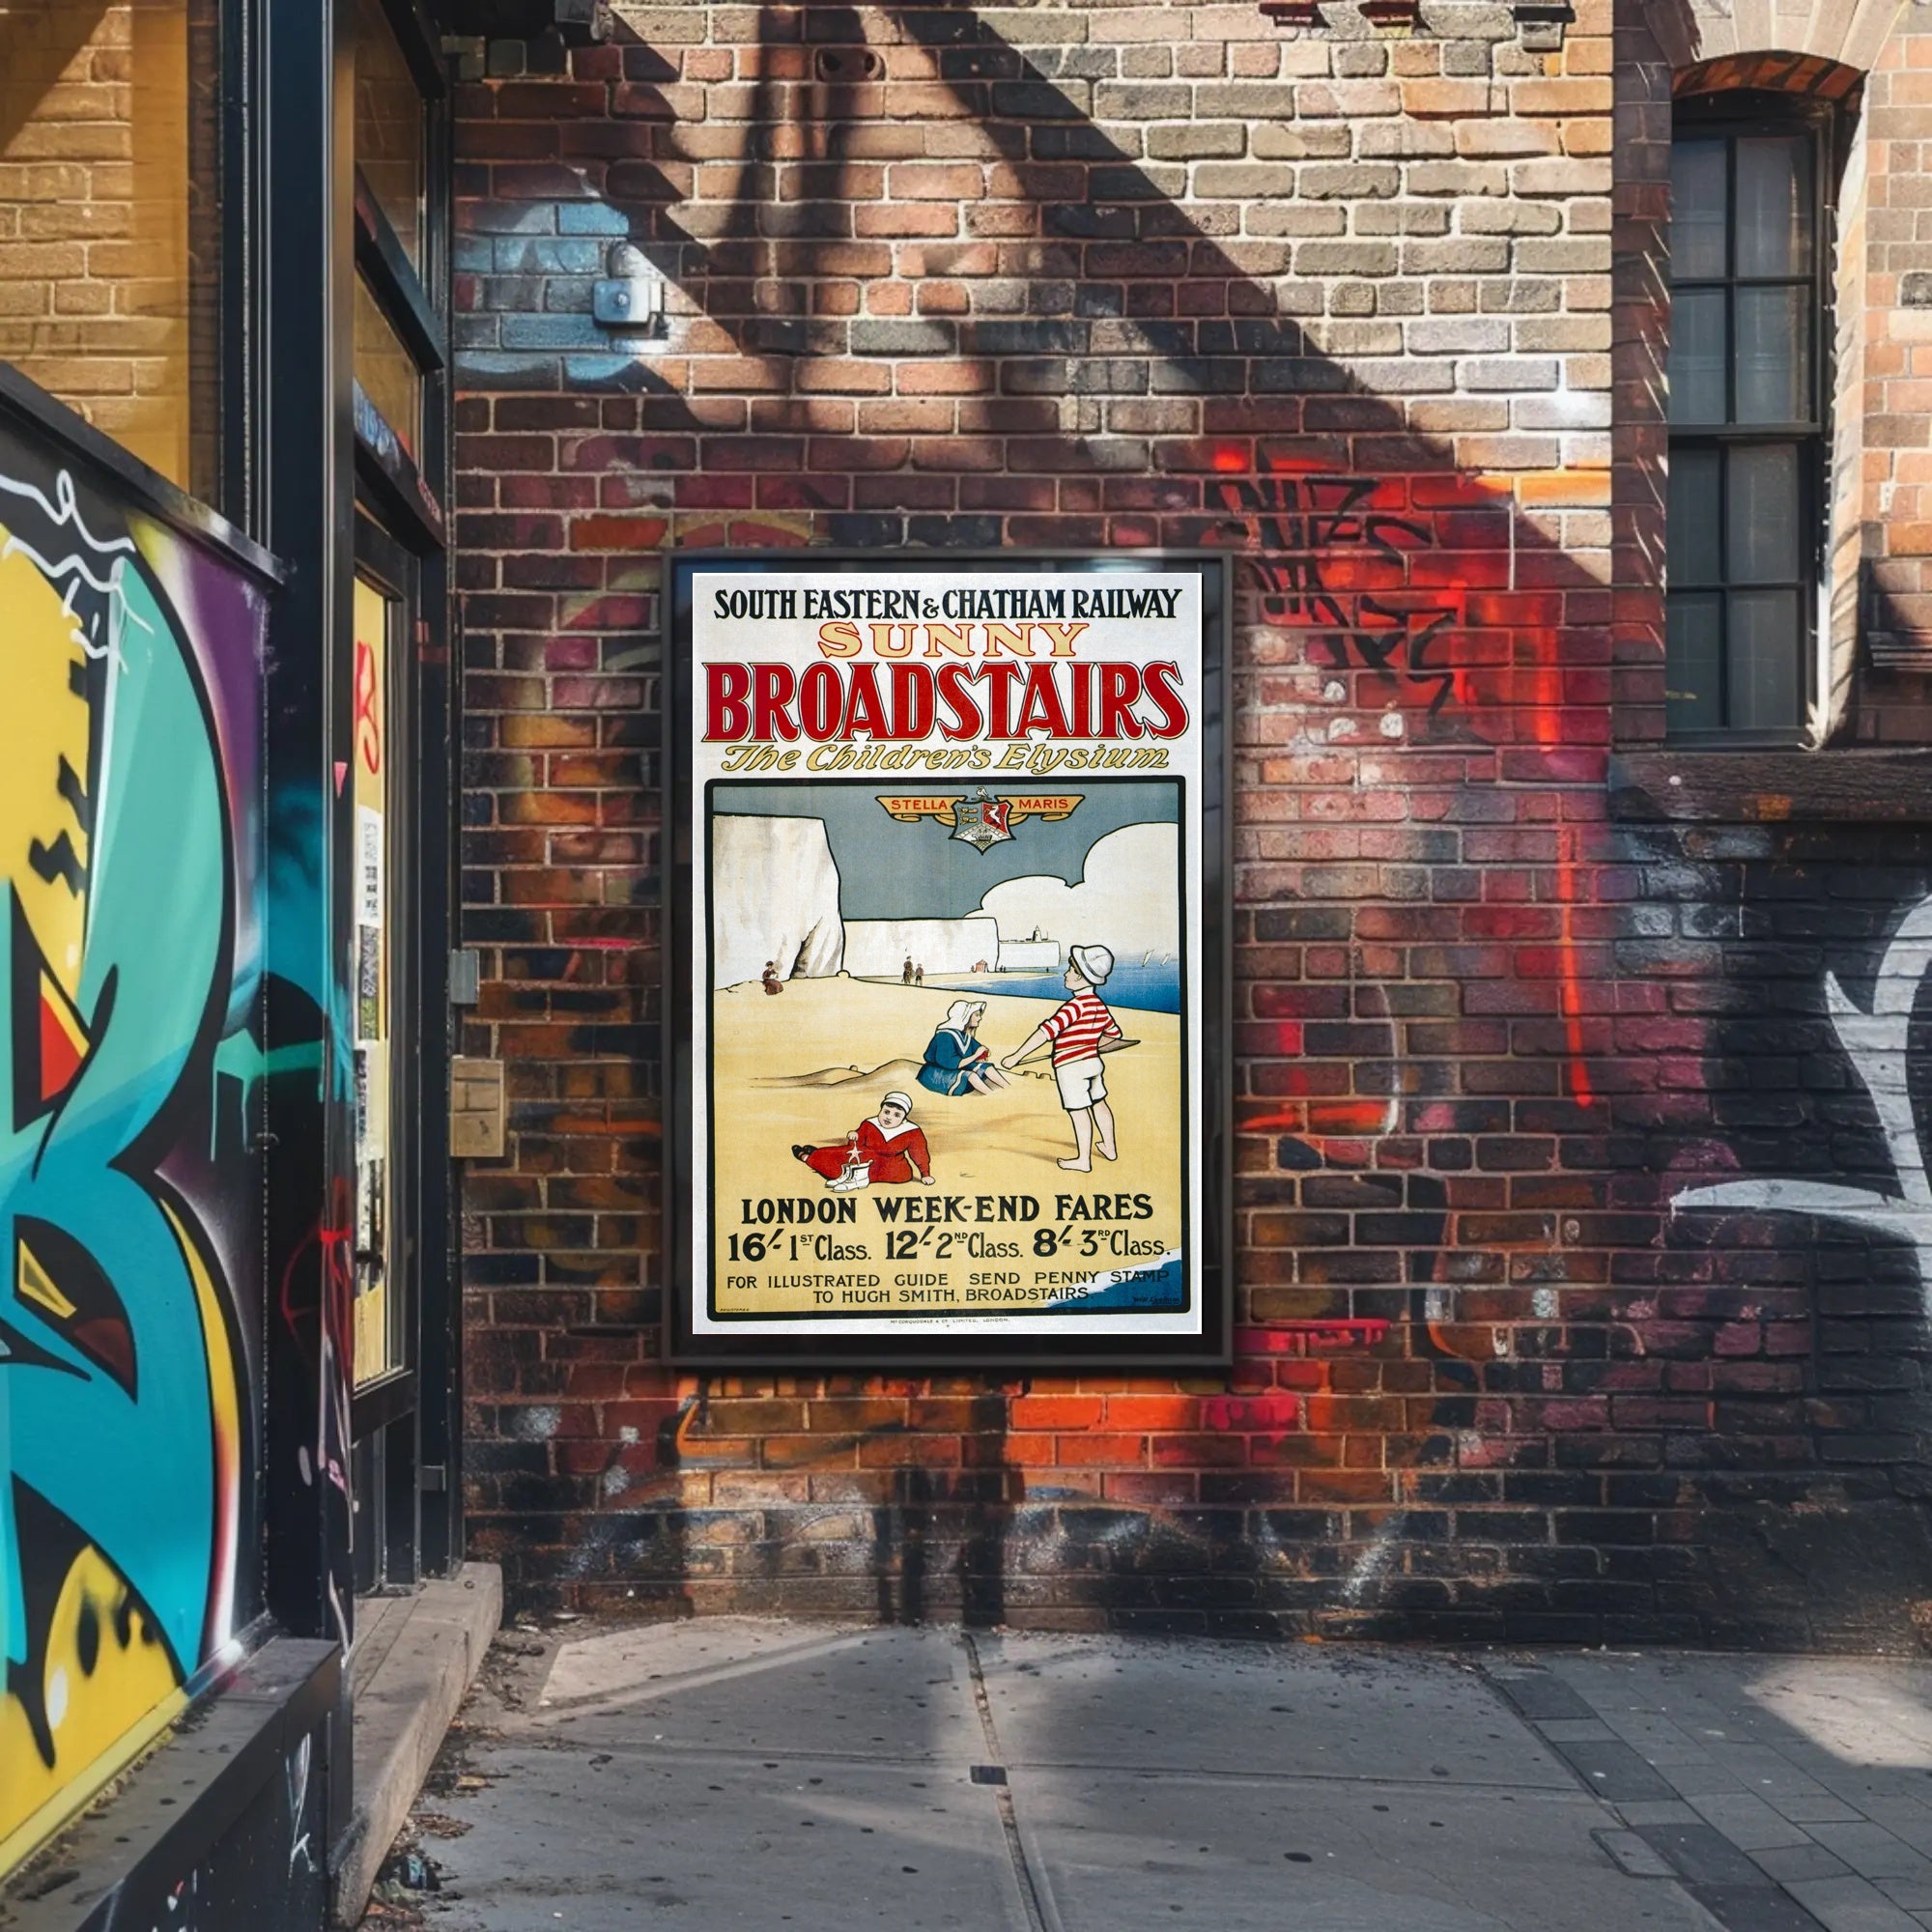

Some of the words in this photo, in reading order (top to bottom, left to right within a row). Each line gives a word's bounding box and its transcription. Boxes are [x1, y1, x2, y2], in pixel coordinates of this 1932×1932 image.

[714, 588, 797, 619] SOUTH
[803, 588, 922, 619] EASTERN
[942, 588, 1065, 619] CHATHAM
[1070, 588, 1182, 619] RAILWAY
[818, 621, 1090, 658] SUNNY
[701, 660, 1190, 743] BROADSTAIRS
[721, 746, 802, 772] The
[806, 745, 992, 772] Children's
[994, 744, 1170, 776] Elysium
[891, 799, 948, 810] STELLA
[1018, 798, 1069, 810] MARIS
[741, 1197, 857, 1225] LONDON
[872, 1195, 1040, 1223] WEEK-END
[1054, 1193, 1153, 1221] FARES
[814, 1234, 871, 1261] Class.
[968, 1232, 1024, 1258] Class.
[1110, 1229, 1171, 1256] Class.
[727, 1275, 757, 1289] FOR
[768, 1274, 880, 1289] ILLUSTRATED
[895, 1273, 949, 1287] GUIDE
[969, 1272, 1020, 1285] SEND
[1035, 1270, 1098, 1284] PENNY
[1110, 1269, 1170, 1283] STAMP
[813, 1291, 833, 1303] TO
[841, 1290, 891, 1303] HUGH
[898, 1289, 960, 1302] SMITH,
